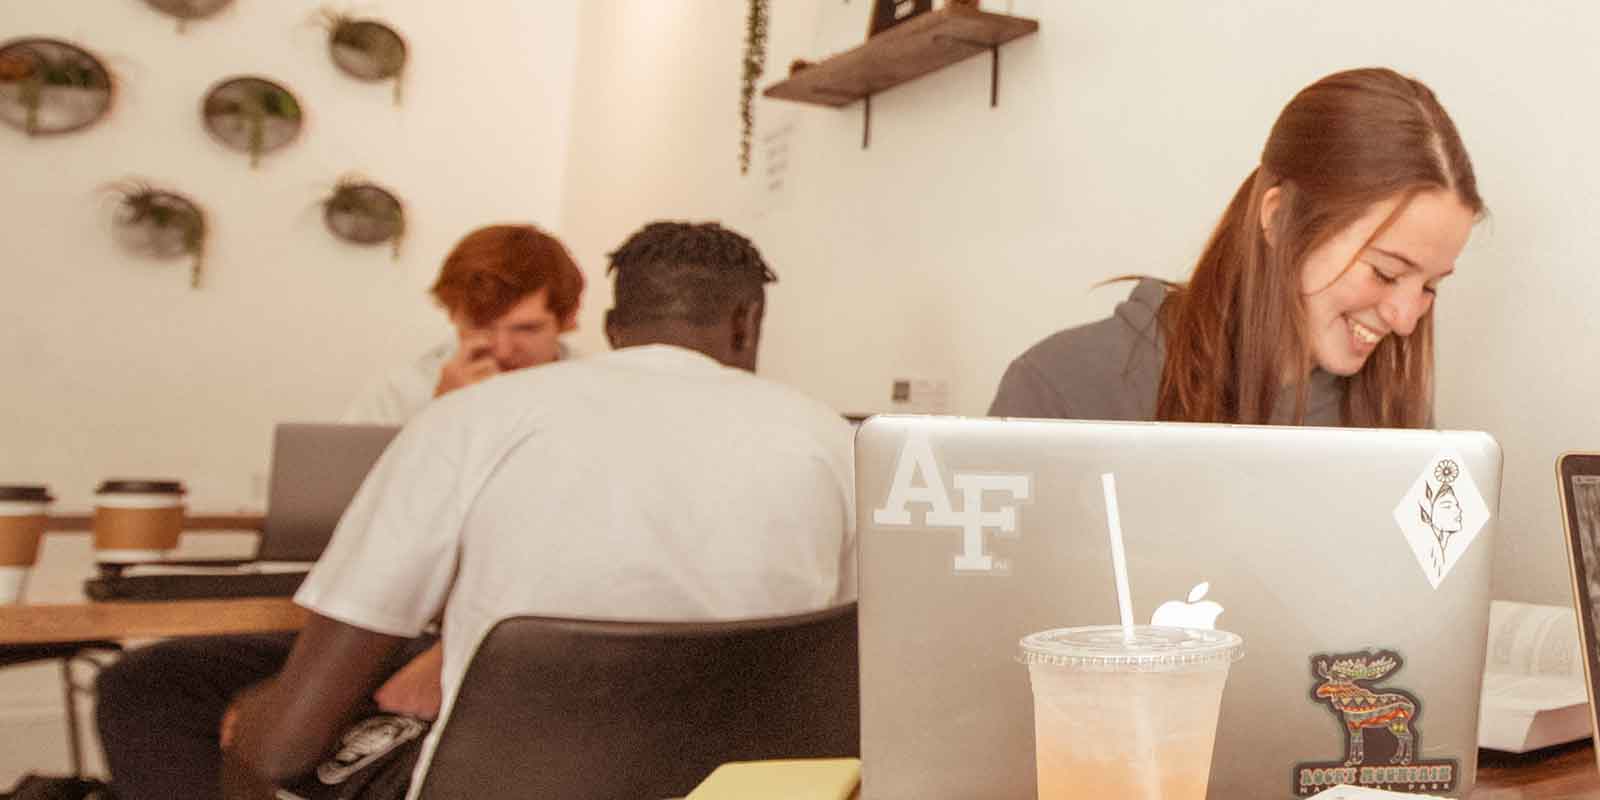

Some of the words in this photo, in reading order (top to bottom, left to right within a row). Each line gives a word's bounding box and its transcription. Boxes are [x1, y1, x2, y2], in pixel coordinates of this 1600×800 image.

[873, 427, 1029, 570] AF
[1301, 769, 1357, 785] ROCKY
[1360, 766, 1452, 783] MOUNTAIN
